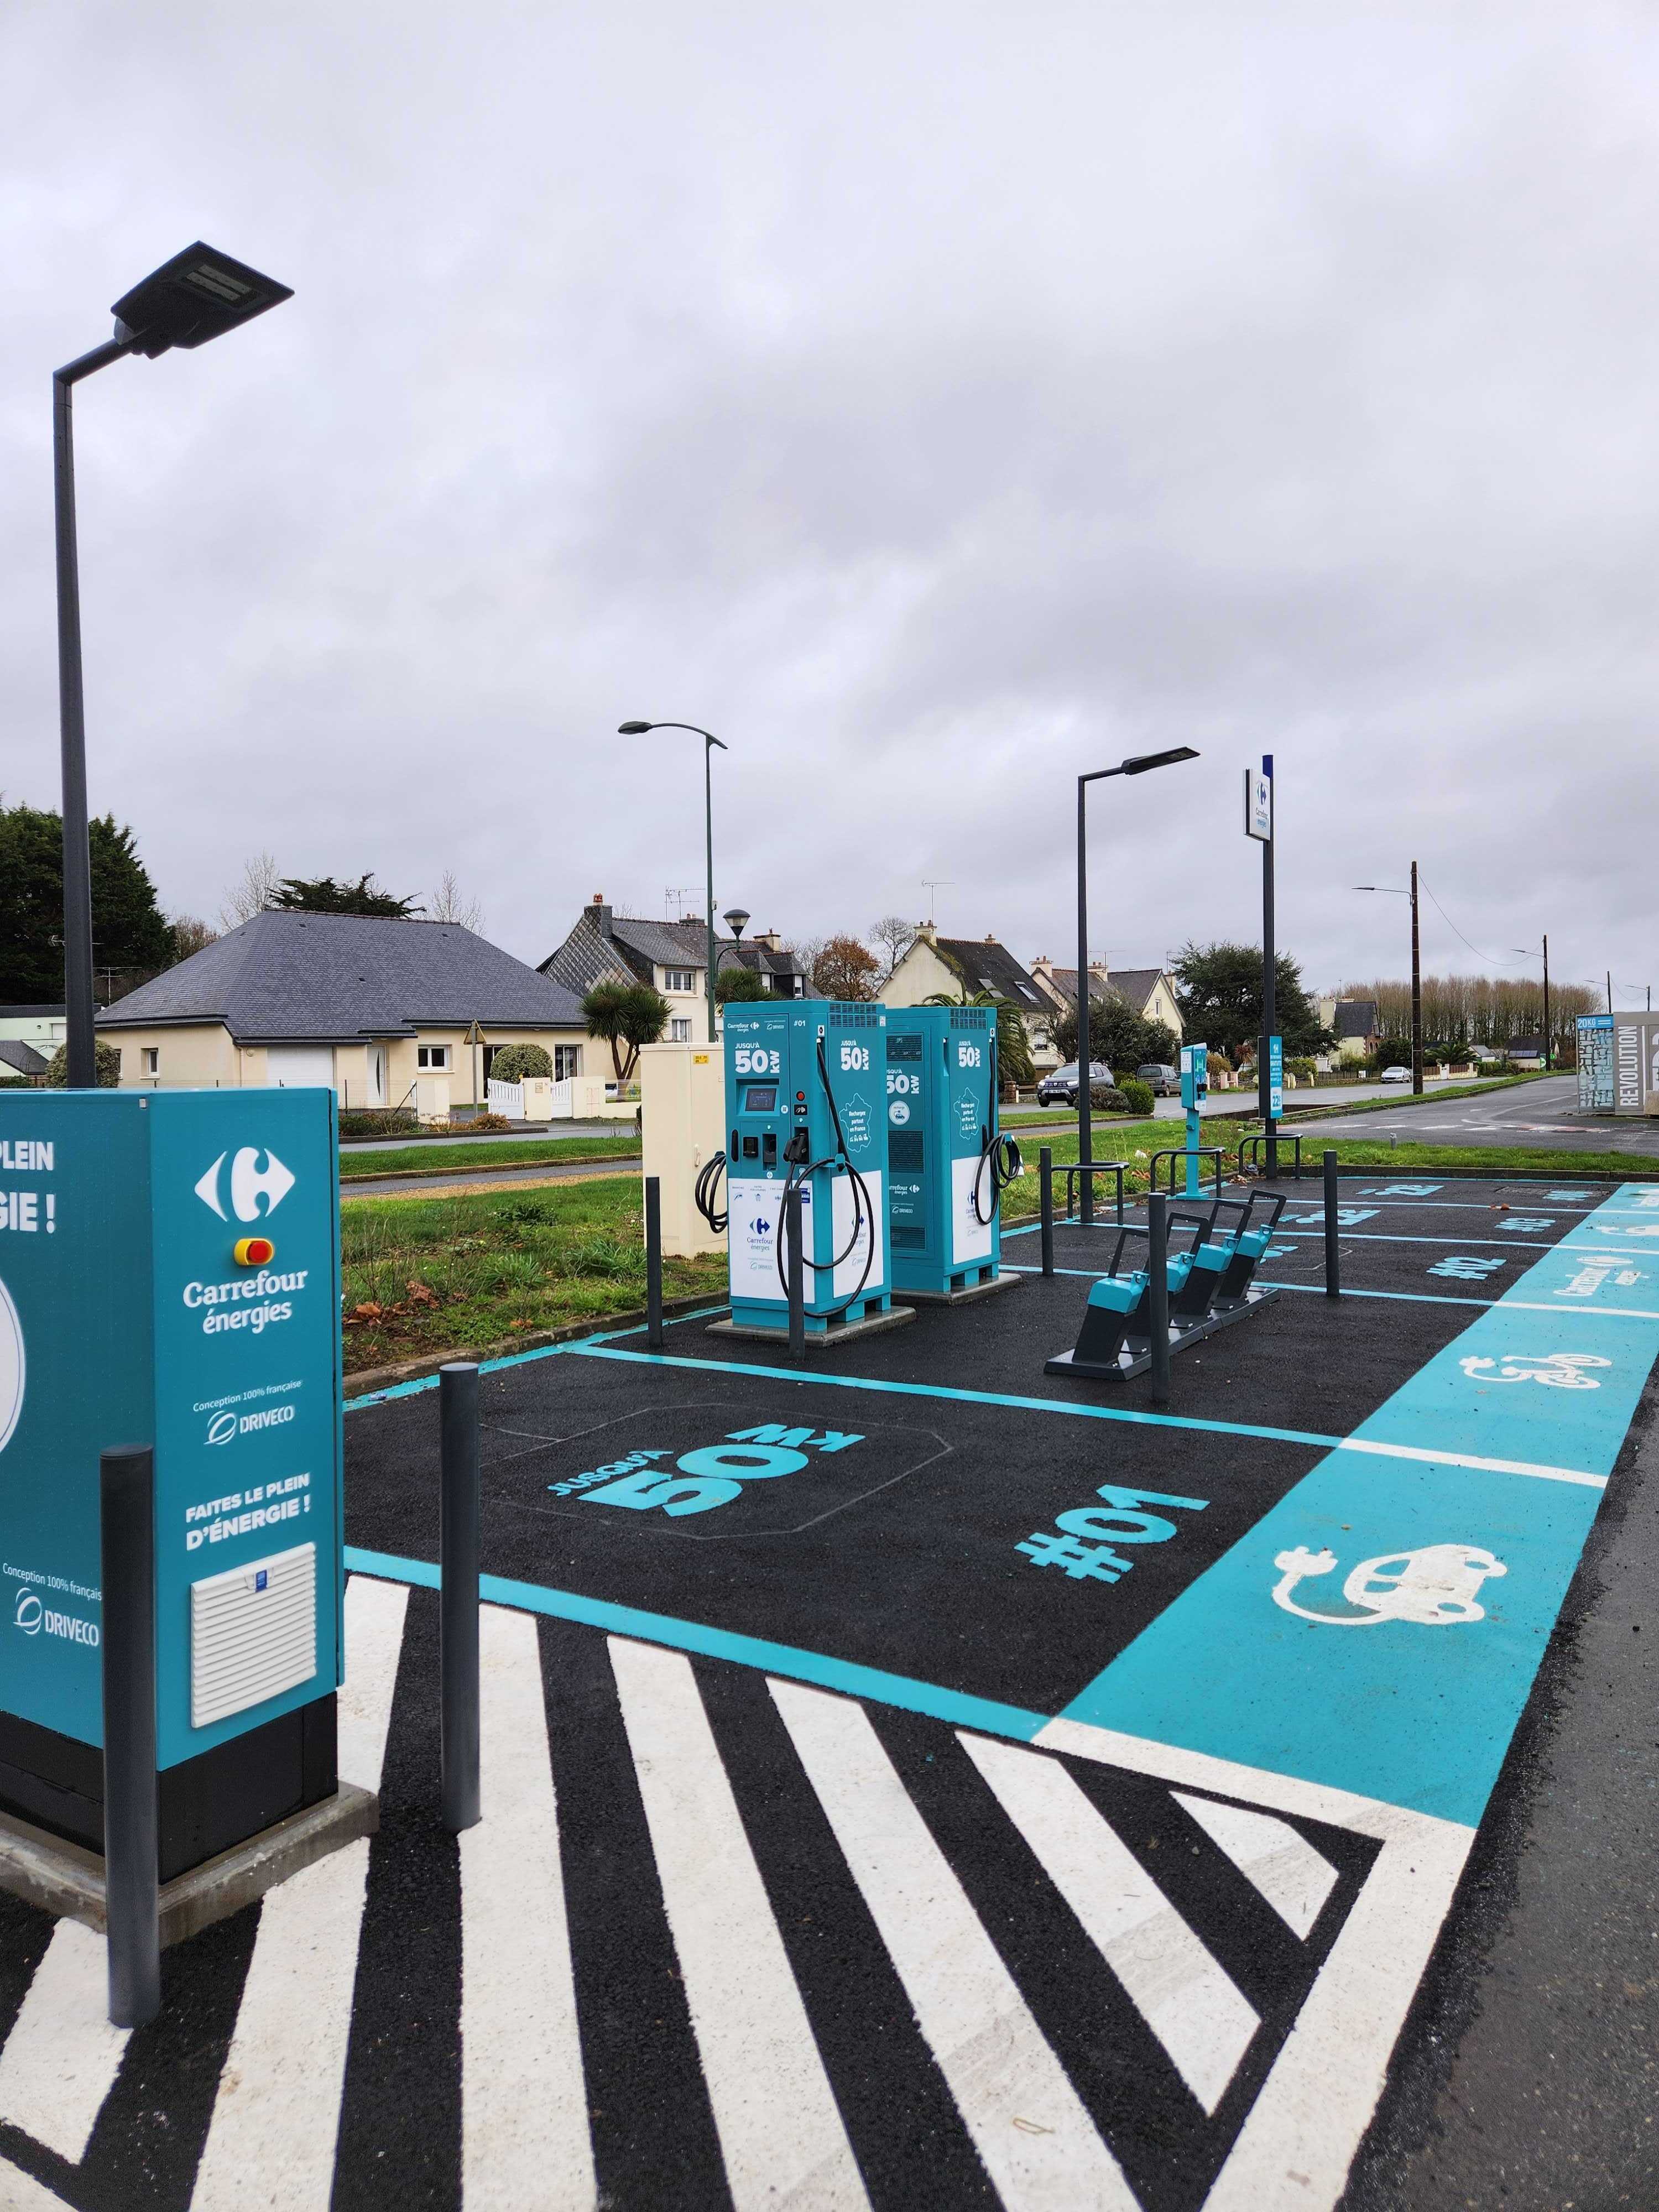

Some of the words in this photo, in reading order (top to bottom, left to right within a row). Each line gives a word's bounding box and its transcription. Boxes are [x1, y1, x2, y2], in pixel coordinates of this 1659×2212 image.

[735, 1050, 769, 1073] 50
[841, 1047, 862, 1071] 50
[958, 1047, 975, 1067] 50
[1618, 1026, 1639, 1106] REVOLUTION
[0, 1141, 54, 1171] LEIN
[1426, 1256, 1507, 1280] #02
[183, 1270, 309, 1307] Carrefour
[202, 1300, 293, 1334] énergies
[193, 1393, 241, 1411] Conception
[242, 1389, 265, 1400] 100%
[266, 1380, 302, 1395] française
[239, 1405, 295, 1433] DRIVECO
[546, 1449, 674, 1496] JUSQU'À
[576, 1444, 810, 1517] 50
[186, 1493, 242, 1523] FAITES
[244, 1486, 263, 1504] LE
[266, 1472, 311, 1498] PLEIN
[186, 1496, 300, 1551] D'ÉNERGIE
[304, 1493, 311, 1512] !
[1014, 1484, 1211, 1584] #01
[3, 1563, 45, 1585] Conception
[47, 1575, 69, 1592] 100%
[70, 1580, 102, 1601] français
[45, 1610, 99, 1647] DRIVECO
